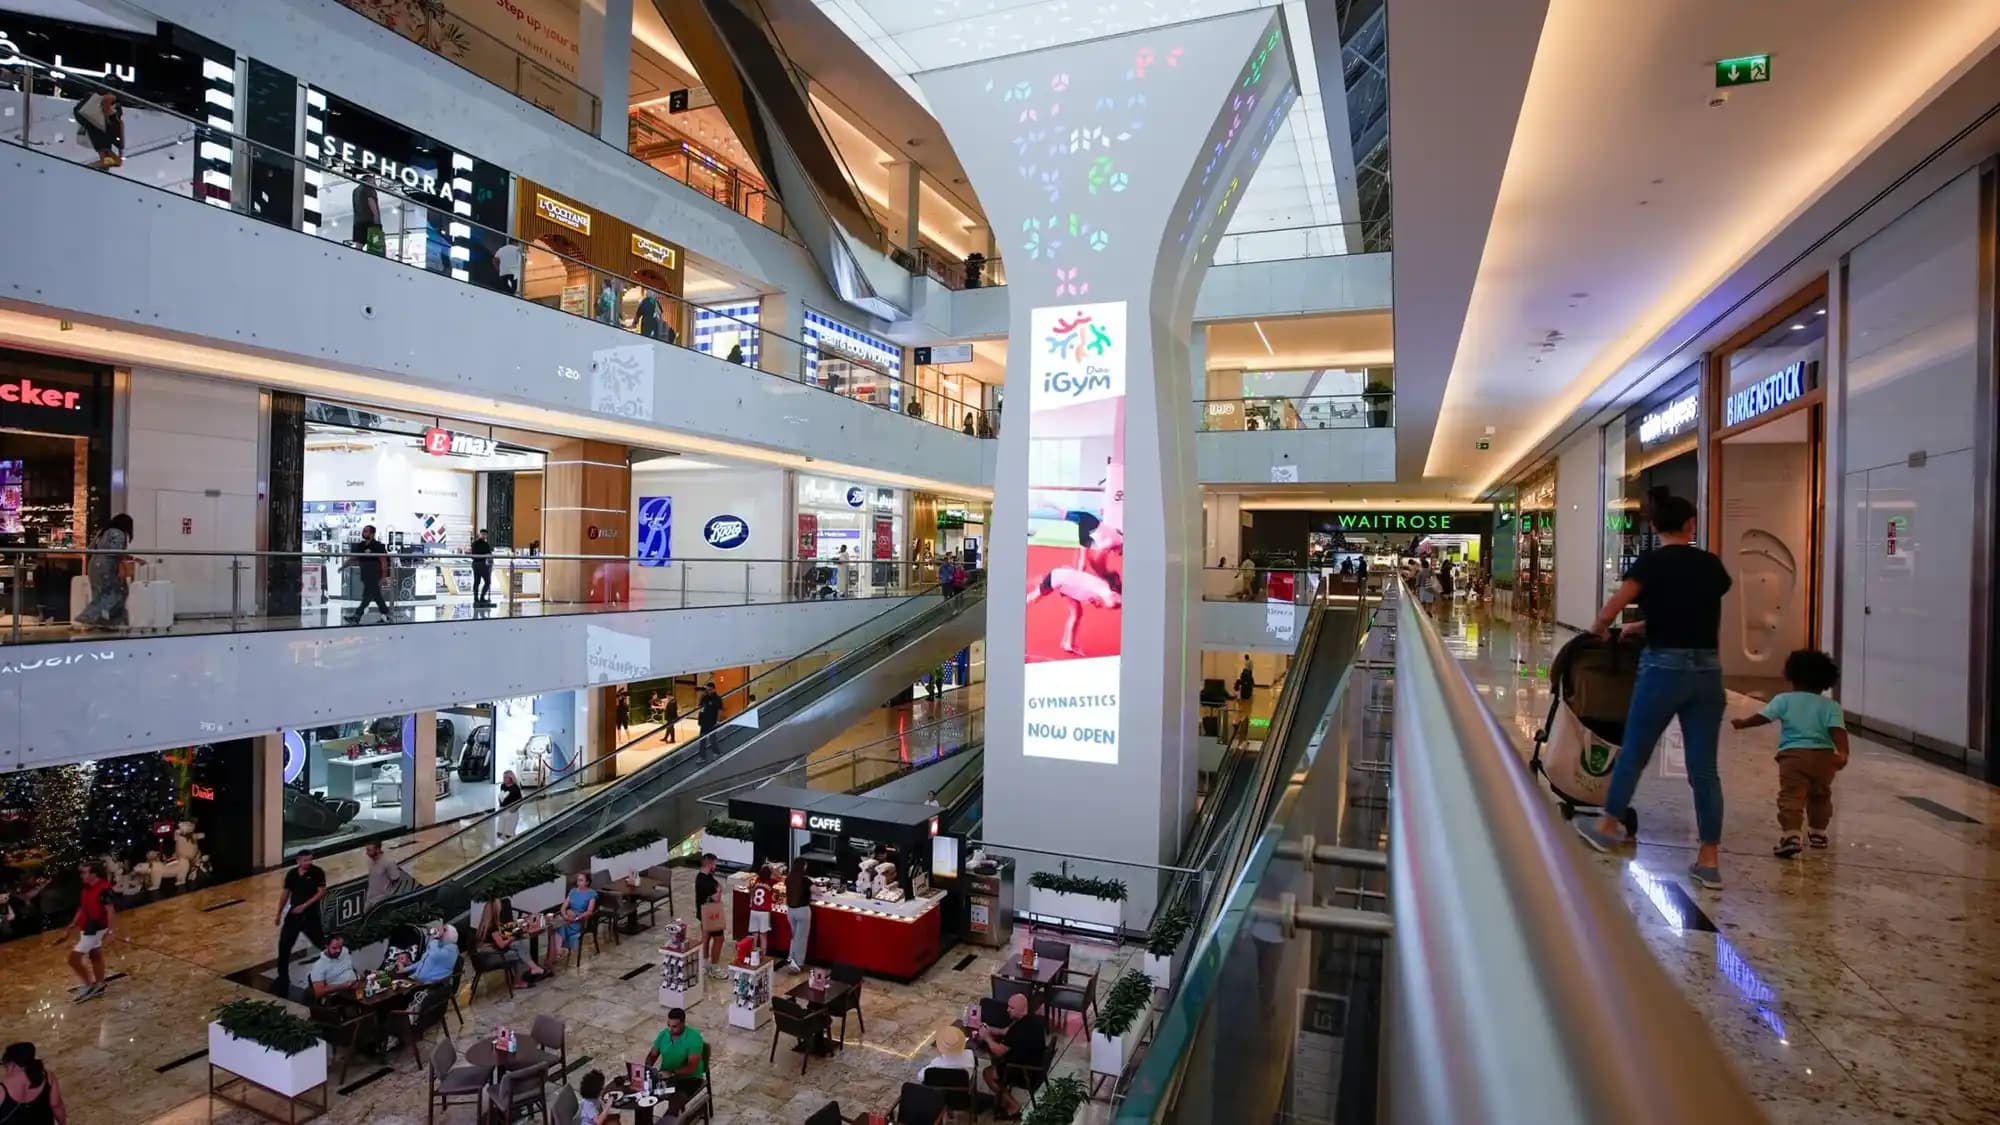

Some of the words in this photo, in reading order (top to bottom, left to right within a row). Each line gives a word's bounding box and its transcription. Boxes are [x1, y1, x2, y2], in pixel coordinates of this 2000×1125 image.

[526, 15, 541, 31] up
[323, 135, 453, 202] SEPHORA
[1044, 371, 1111, 397] iGym
[1726, 360, 1804, 427] BIRKENSTOCK
[1338, 514, 1451, 529] WAITROSE
[1028, 694, 1116, 710] GYMNASTICS
[1027, 722, 1068, 740] NOW
[1072, 727, 1115, 745] OPEN
[753, 888, 766, 906] 8
